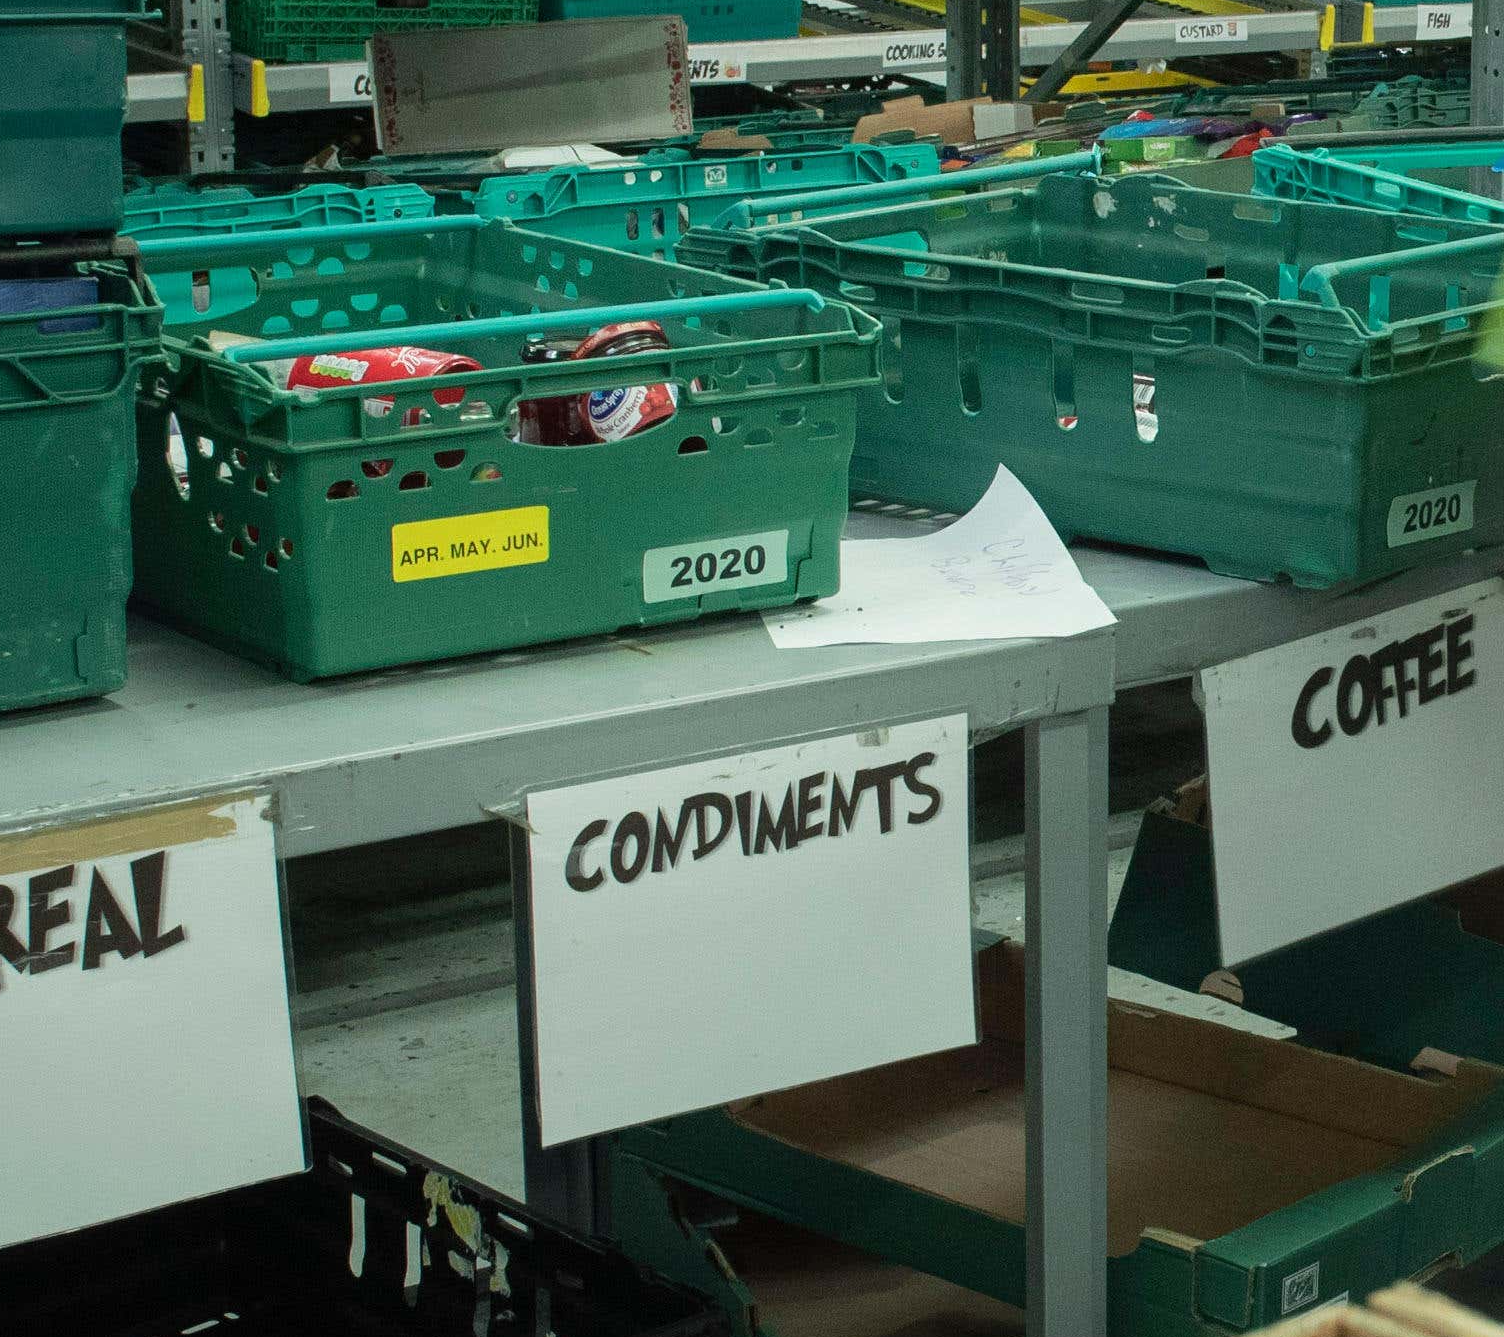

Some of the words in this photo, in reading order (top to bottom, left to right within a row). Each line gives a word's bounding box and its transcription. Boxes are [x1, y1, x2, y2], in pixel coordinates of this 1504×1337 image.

[1179, 23, 1224, 39] CUSTARD
[1427, 12, 1451, 29] FISH
[885, 43, 936, 62] COOKING
[1403, 493, 1461, 534] 2020
[399, 547, 444, 567] APR.
[451, 540, 496, 560] MAY.
[502, 533, 544, 553] JUN.
[670, 545, 766, 589] 2020
[1291, 614, 1476, 749] COFFEE
[564, 751, 941, 893] CONDIMENTS
